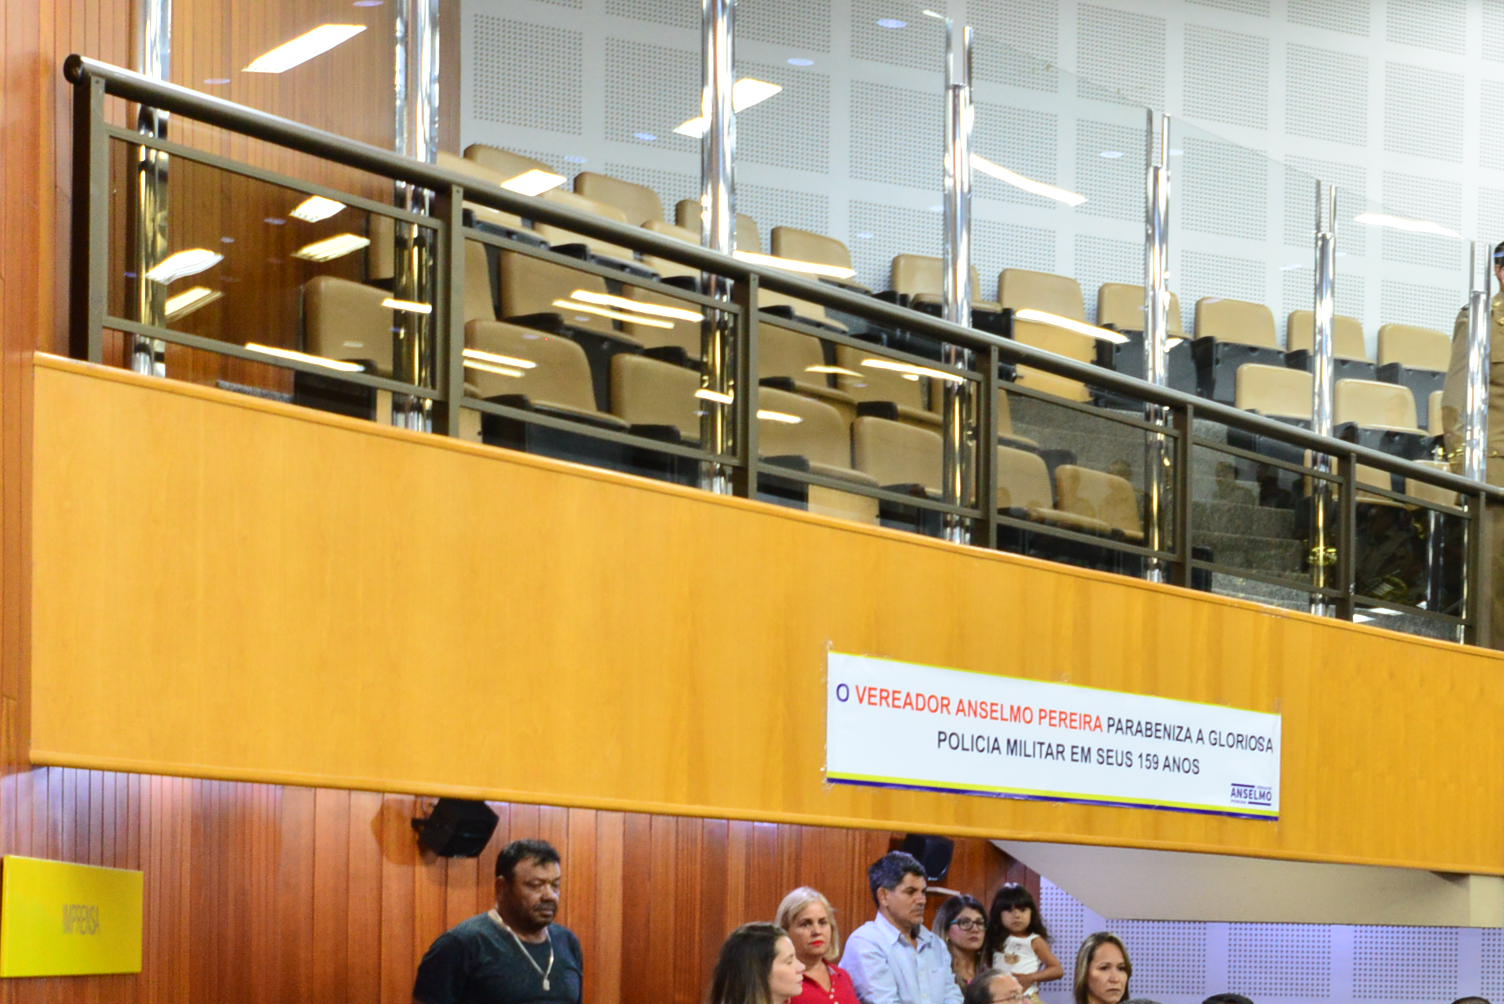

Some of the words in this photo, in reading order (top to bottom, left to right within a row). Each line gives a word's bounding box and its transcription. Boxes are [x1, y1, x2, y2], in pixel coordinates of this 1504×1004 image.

[836, 683, 850, 702] O
[855, 685, 951, 715] VEREADOR
[956, 698, 1034, 725] ANSELMO
[1038, 708, 1103, 732] PEREIRA
[1107, 716, 1193, 743] PARABENIZA
[1196, 729, 1205, 745] A
[1208, 730, 1274, 753] GLORIOSA
[937, 731, 1002, 755] POLICIA
[1006, 738, 1066, 761] MILITAR
[1071, 745, 1092, 764] EM
[1096, 748, 1133, 768] SEUS
[1138, 753, 1158, 770] 159
[1162, 755, 1200, 775] ANOS
[1231, 787, 1272, 801] ANSELMO
